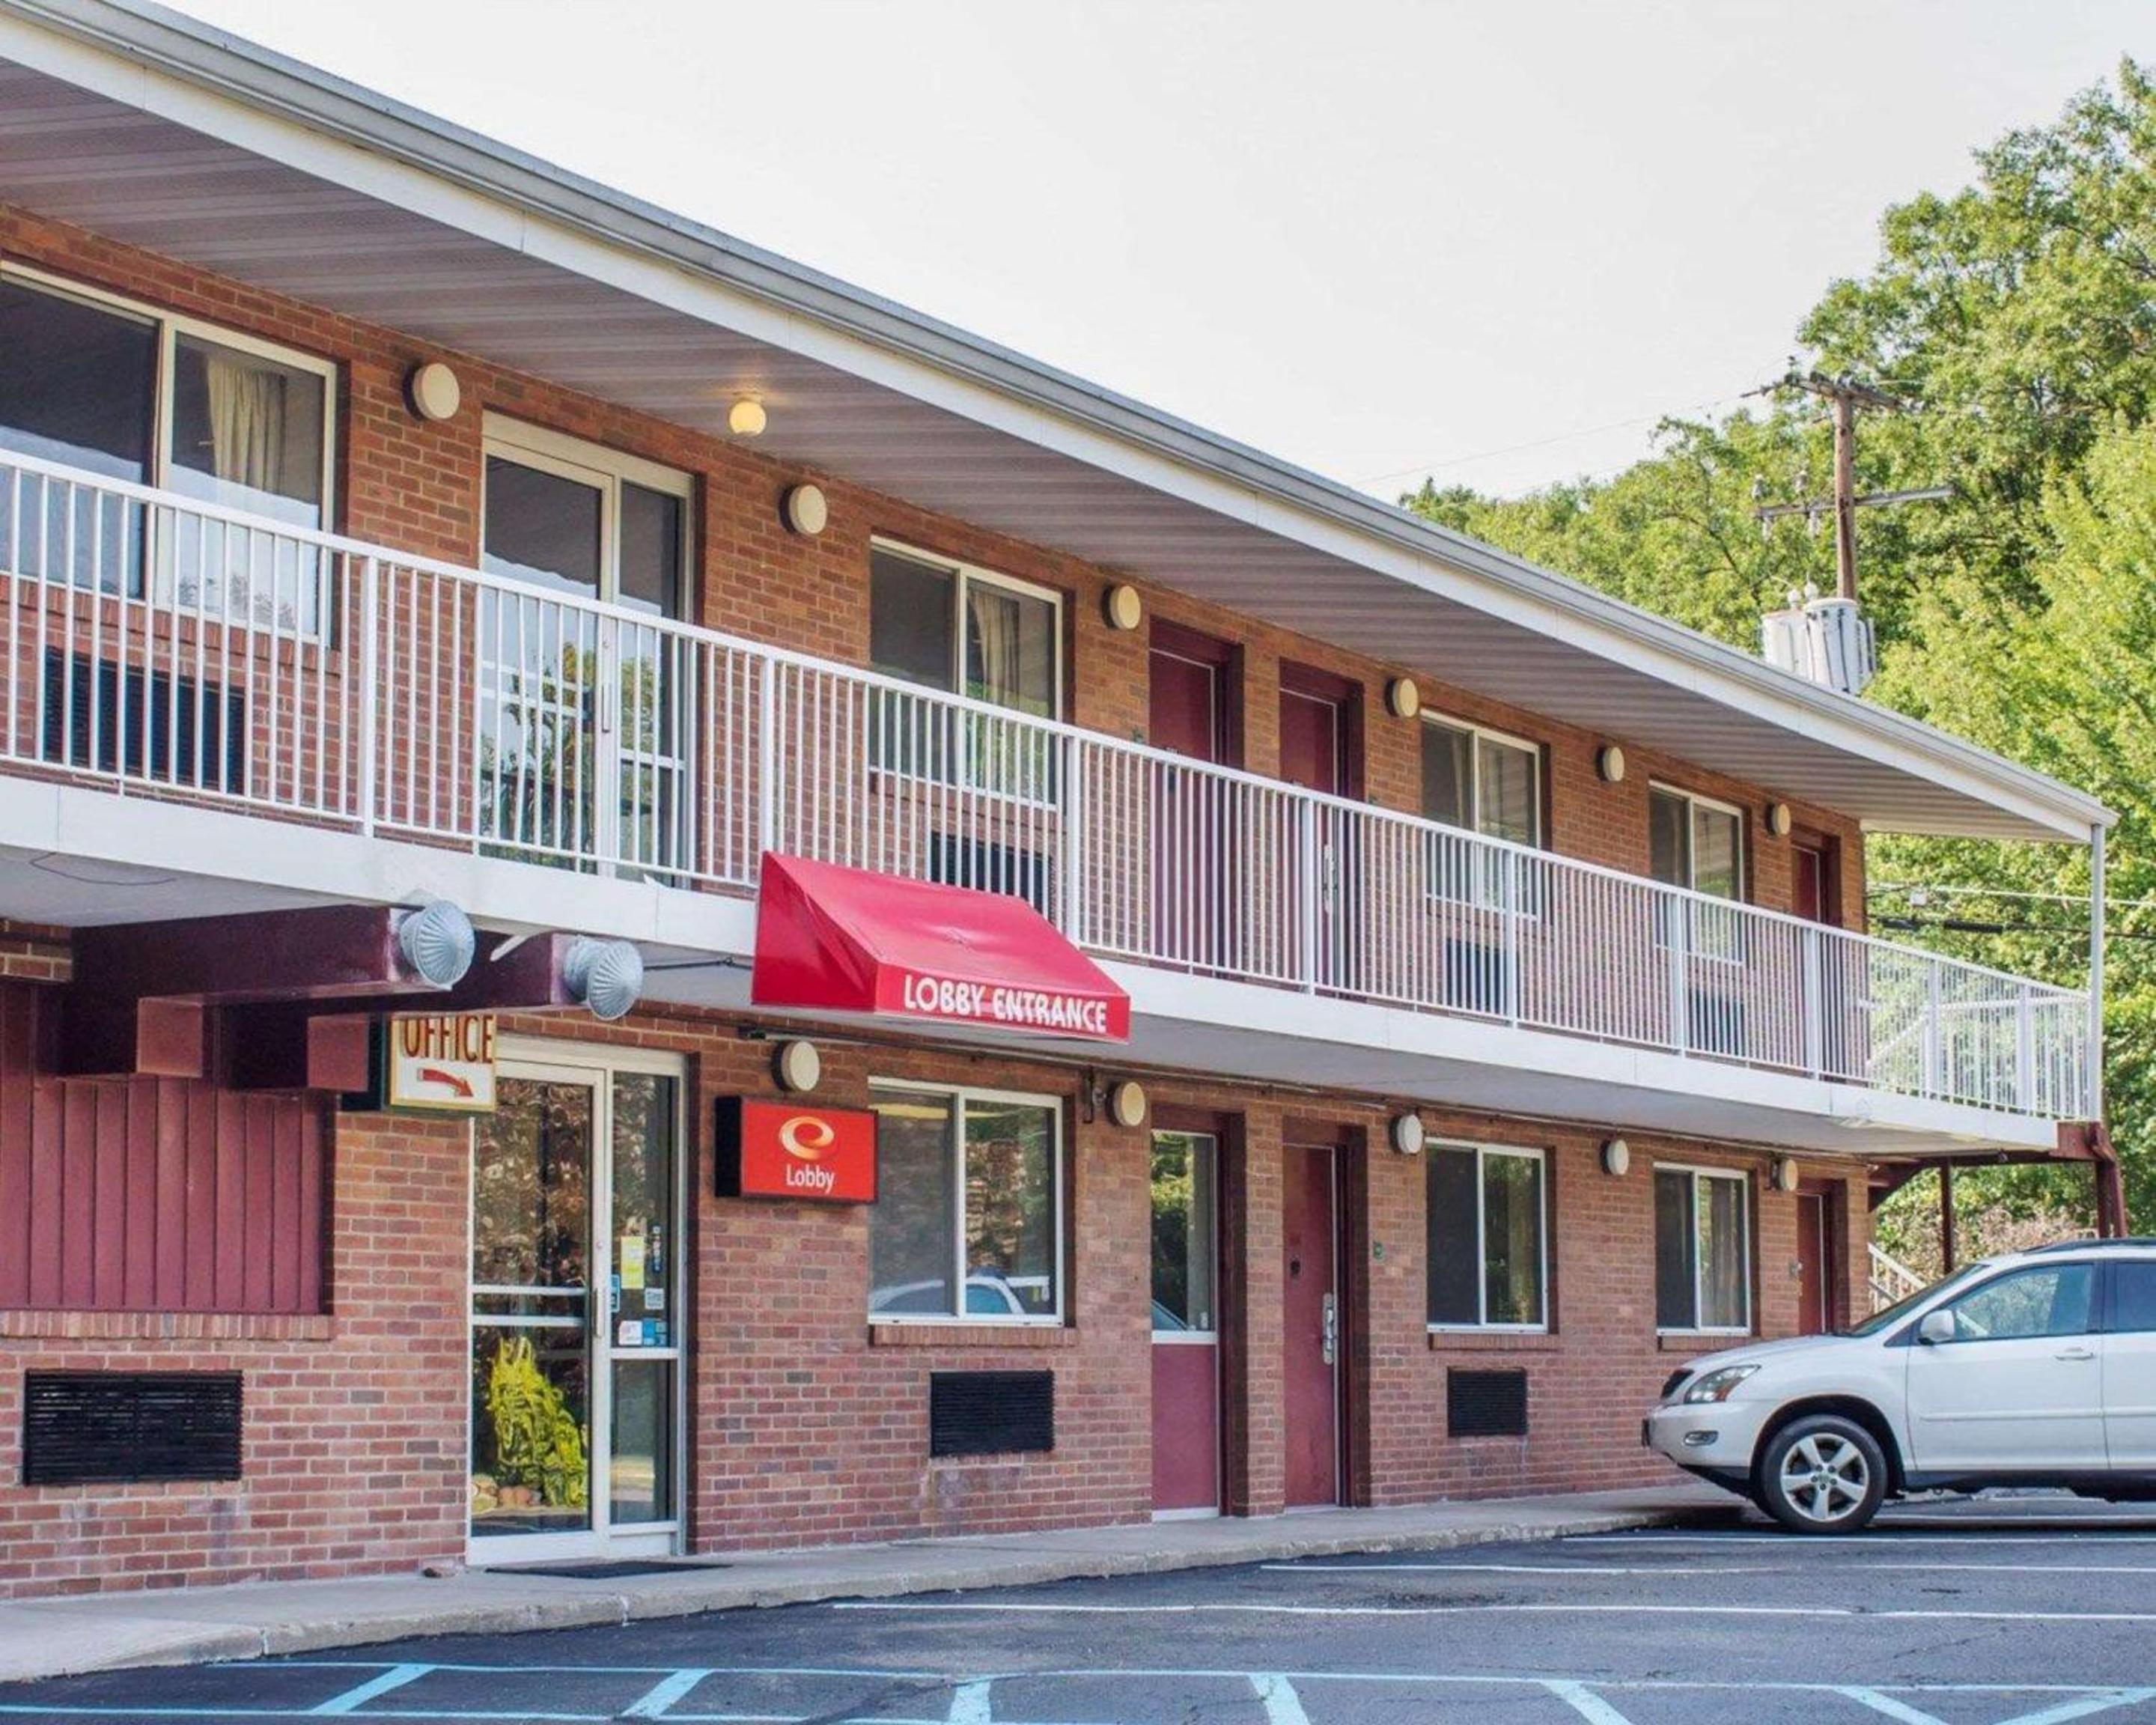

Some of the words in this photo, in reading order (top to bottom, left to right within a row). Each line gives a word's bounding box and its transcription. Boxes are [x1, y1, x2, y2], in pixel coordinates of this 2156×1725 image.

[903, 974, 986, 1017] LOBBY
[993, 988, 1107, 1033] ENTRANCE
[401, 1014, 493, 1063] OFFICE
[786, 1164, 835, 1193] Lobby
